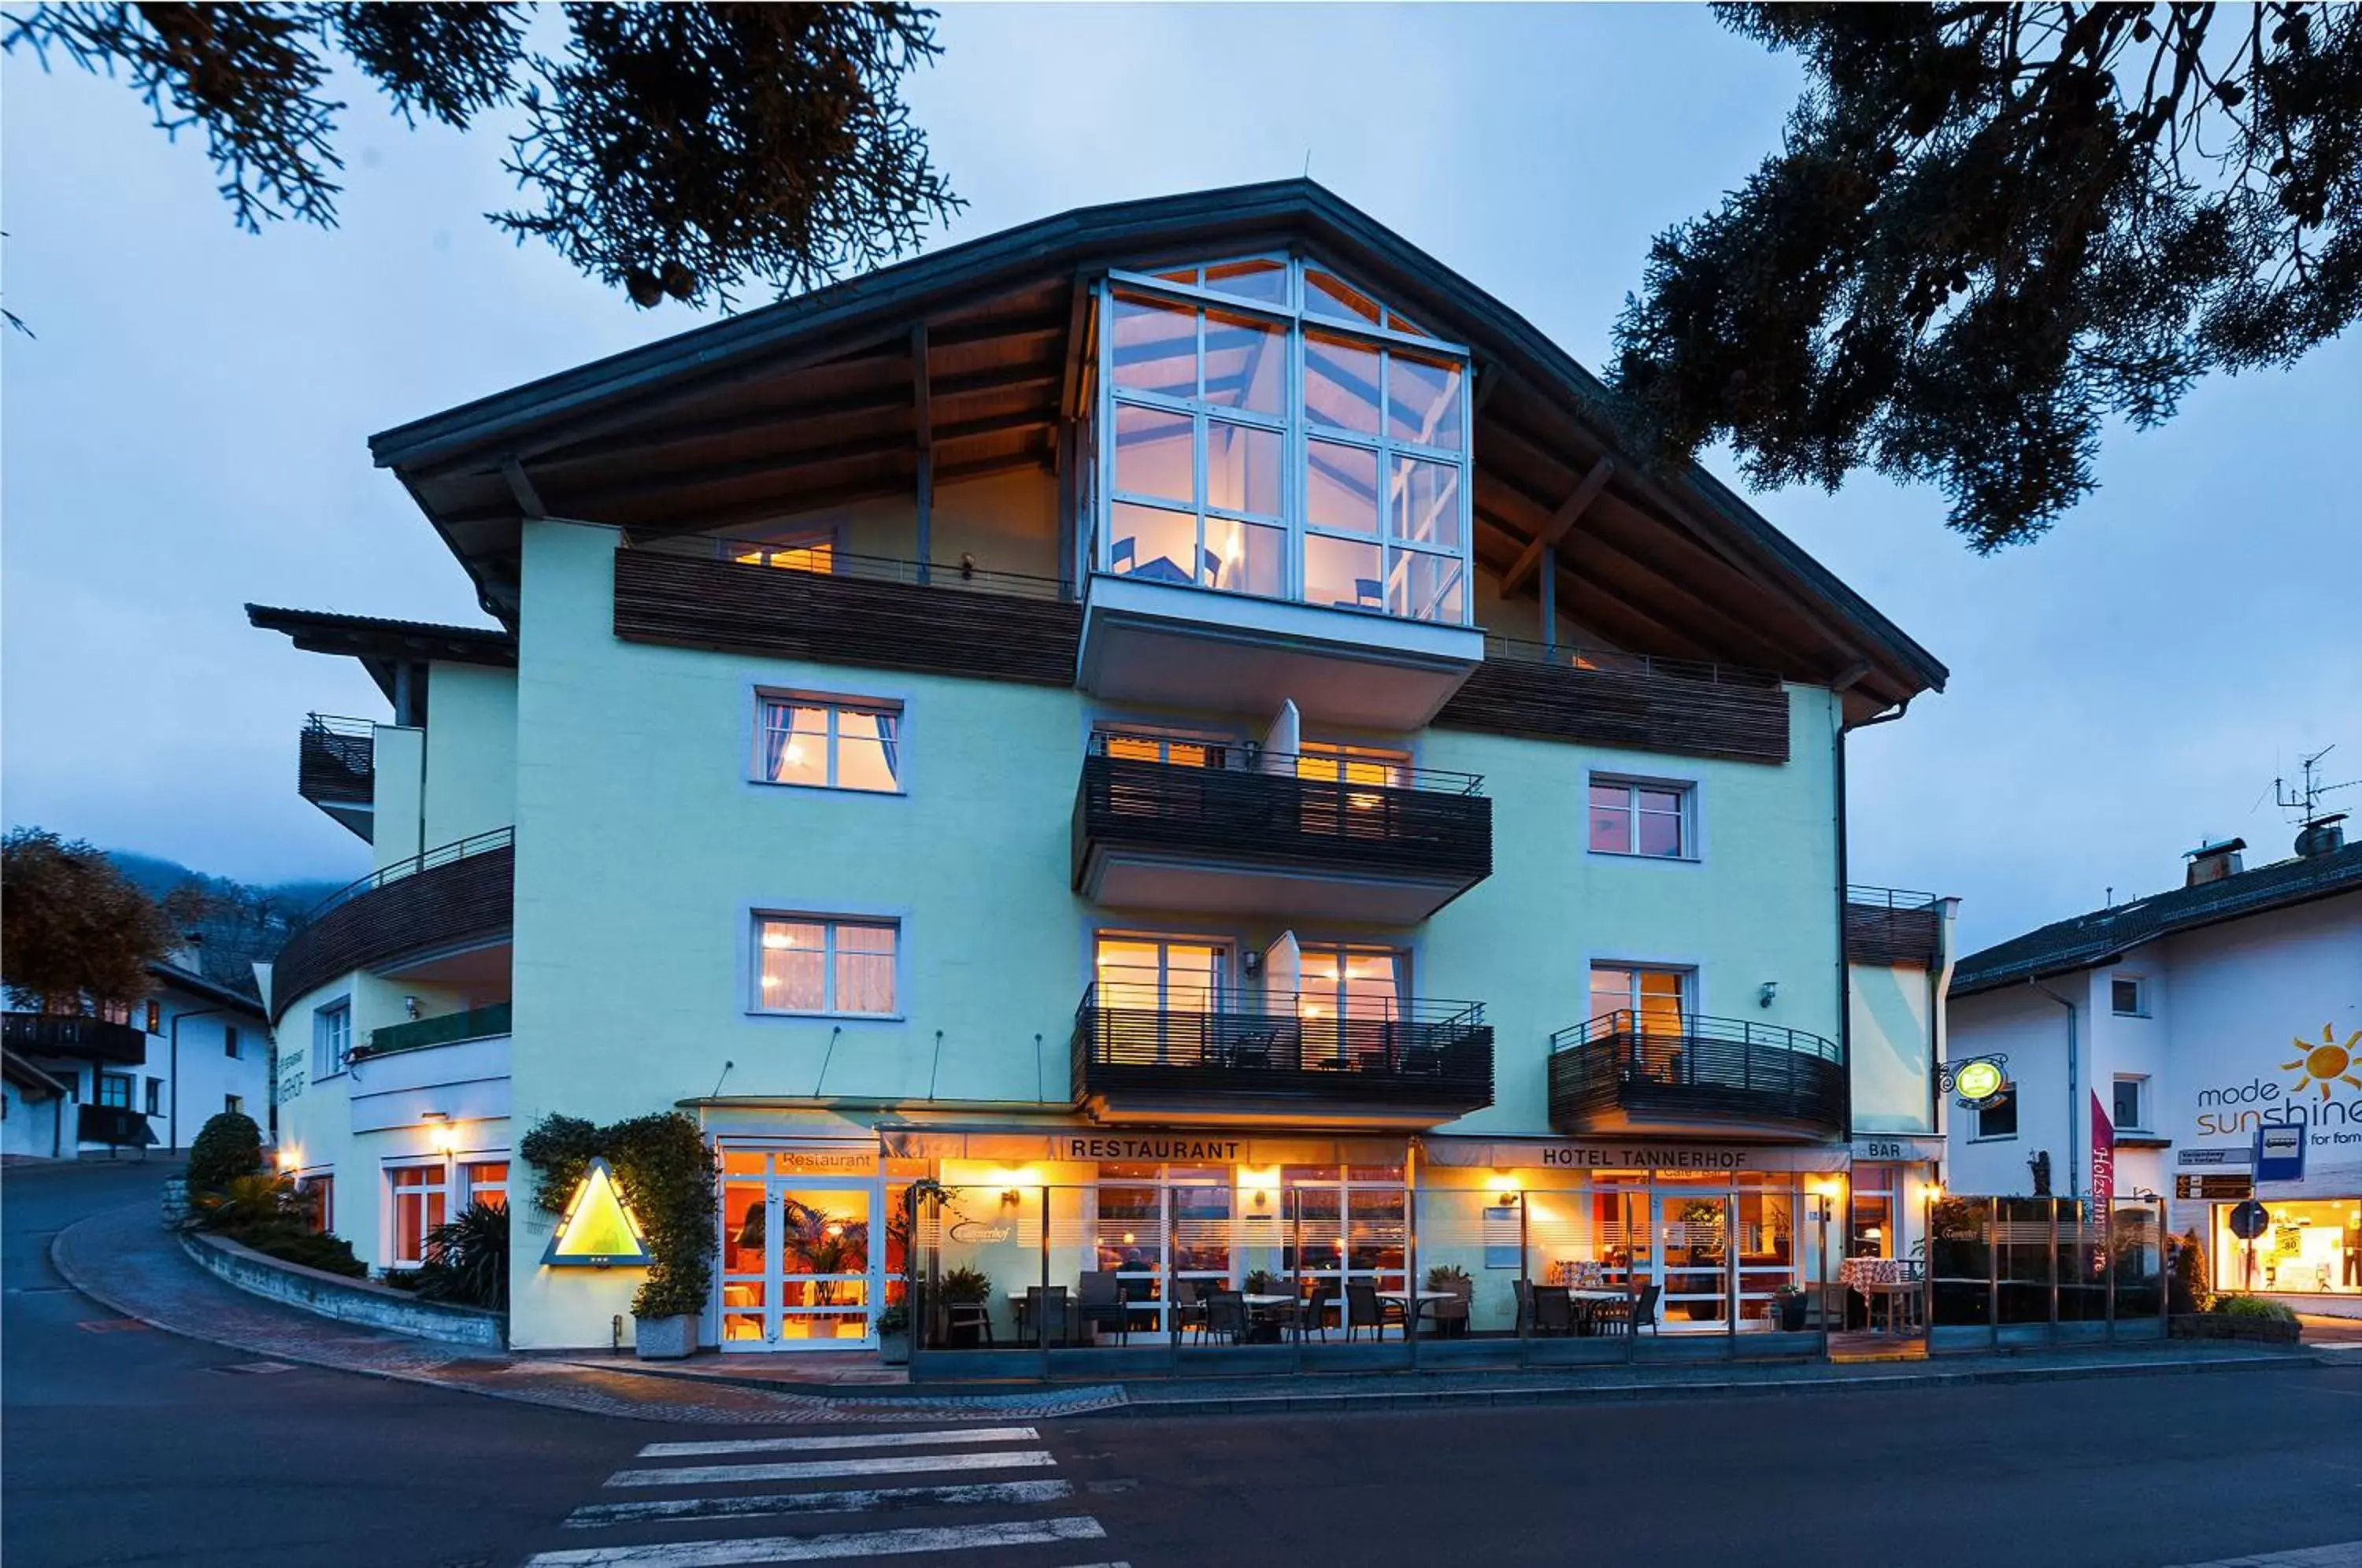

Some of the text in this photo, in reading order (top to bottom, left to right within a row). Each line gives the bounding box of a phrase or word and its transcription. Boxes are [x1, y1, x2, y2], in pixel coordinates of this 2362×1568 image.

[2198, 1078, 2281, 1107] mode
[2311, 1133, 2331, 1145] for
[1072, 1139, 1239, 1159] RESTAURANT
[1869, 1144, 1900, 1157] BAR
[783, 1152, 870, 1167] Restaurant
[1544, 1149, 1747, 1168] HOTEL TANNERHOF
